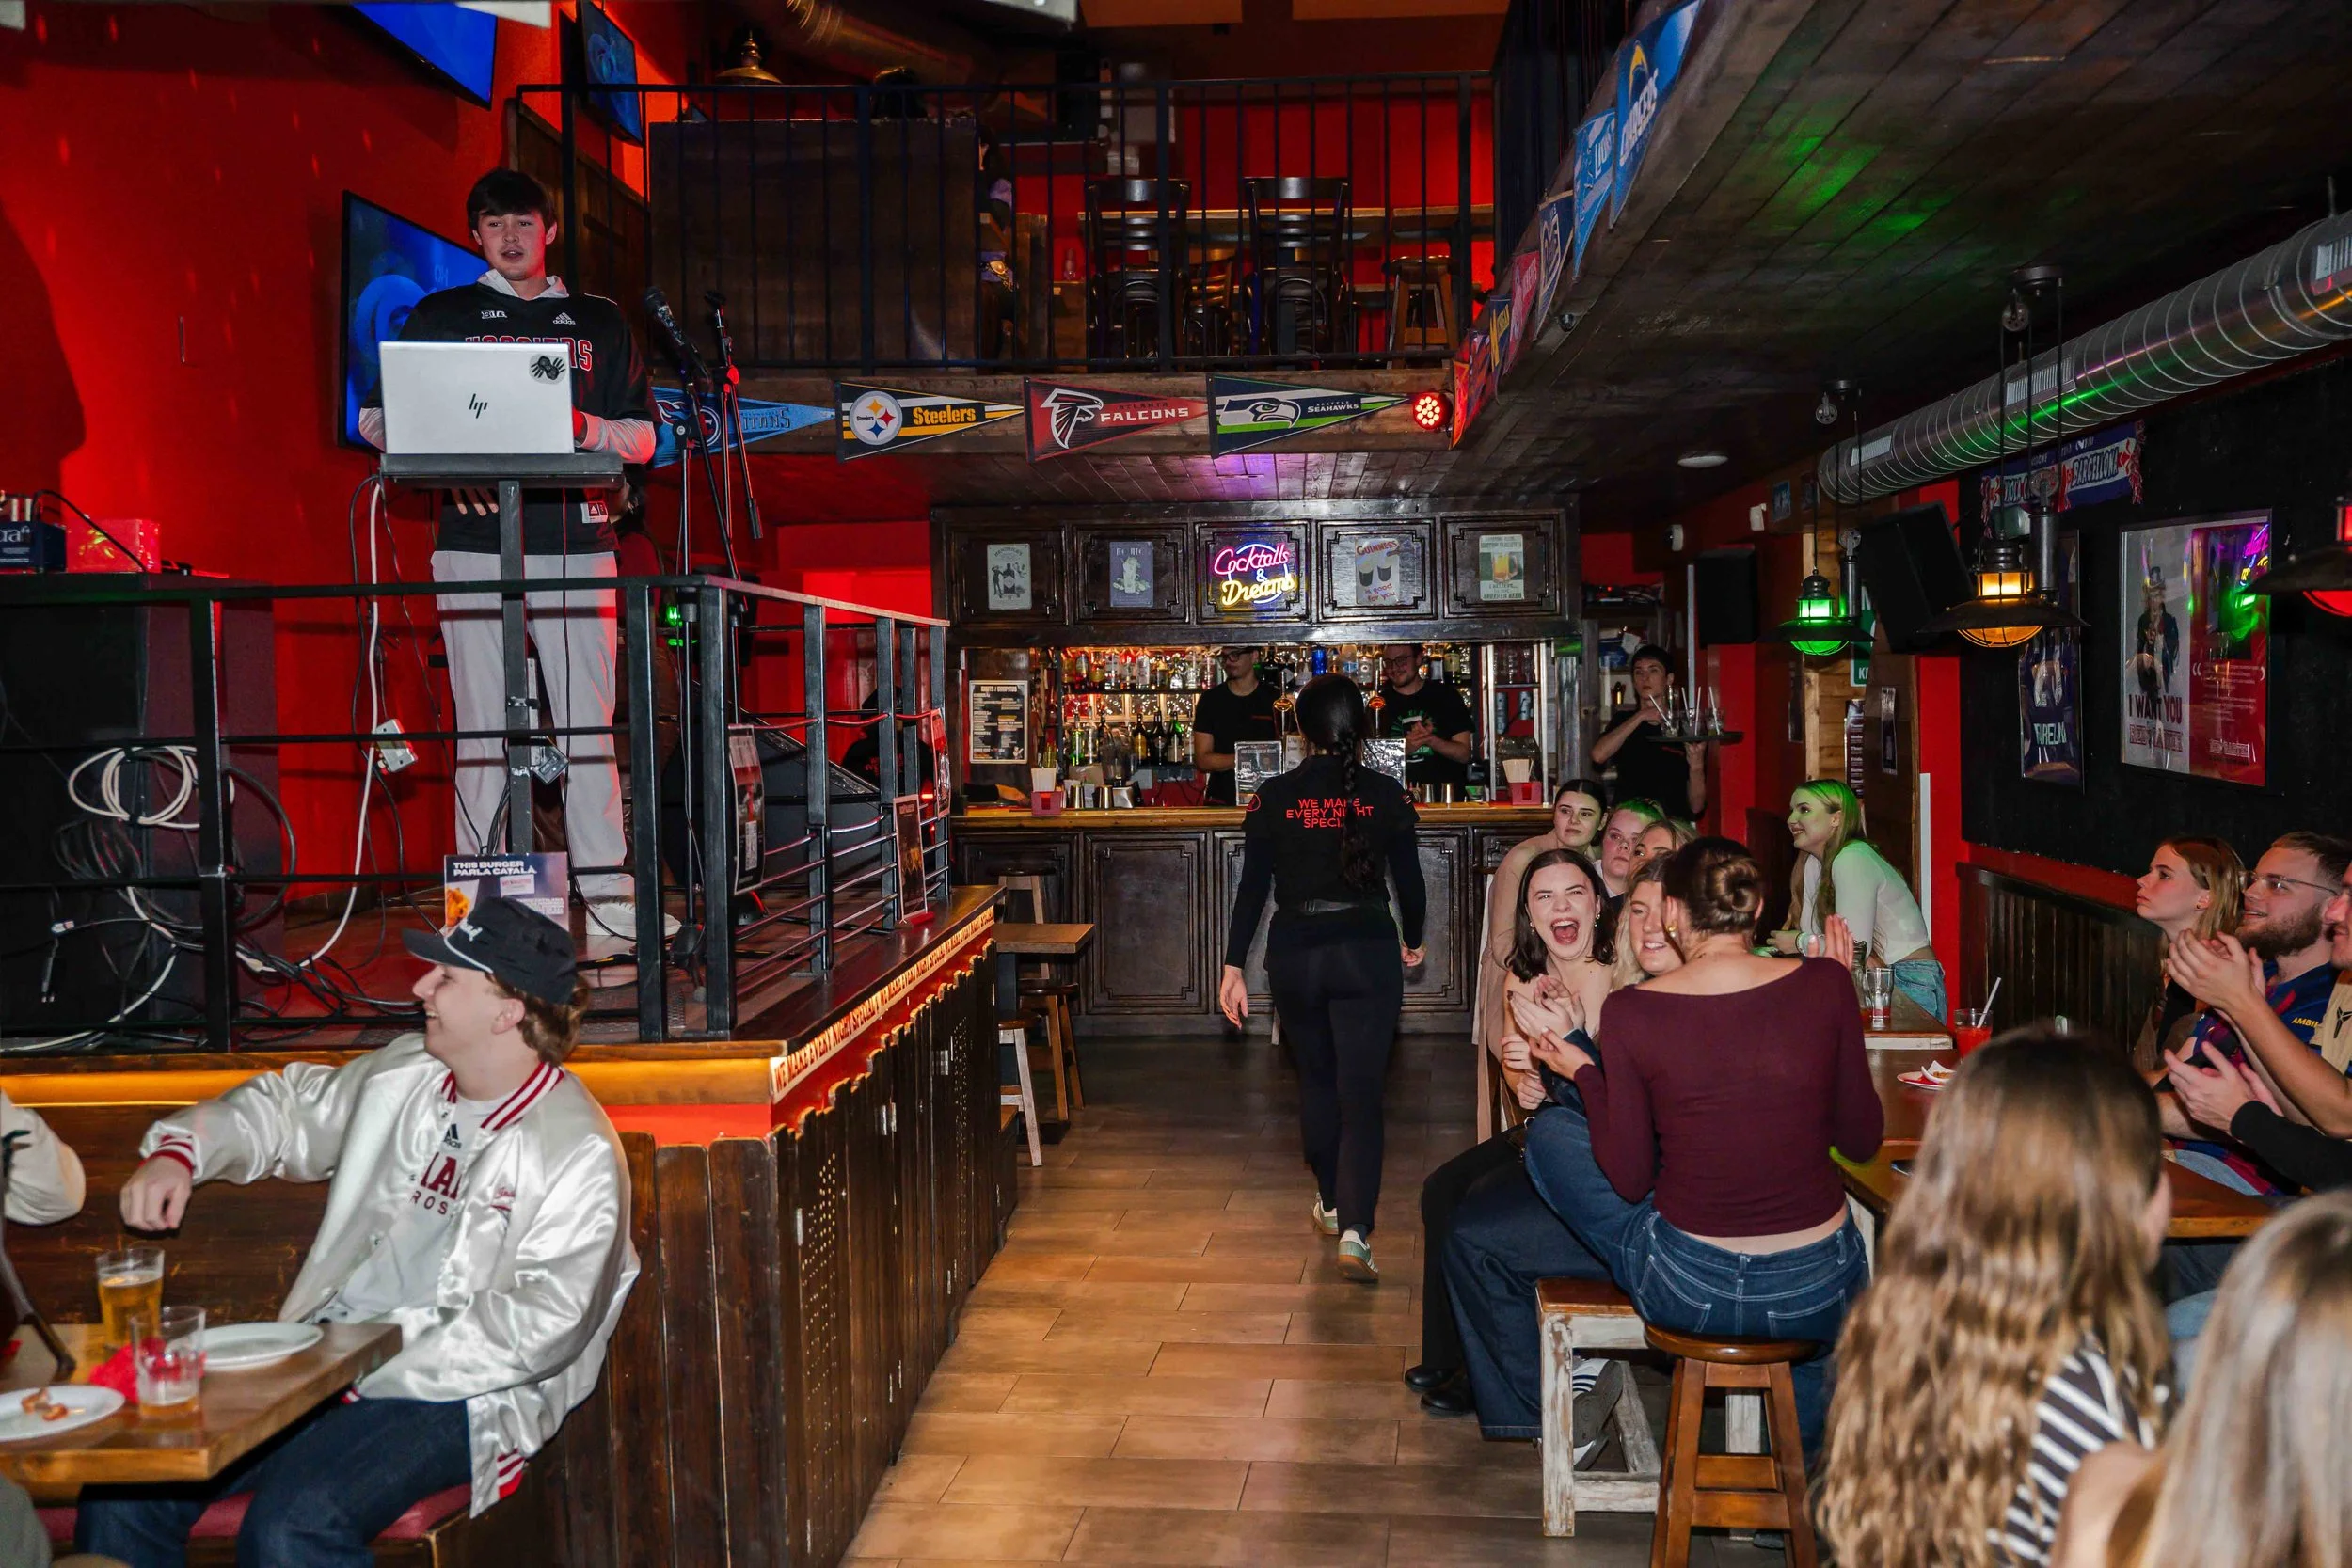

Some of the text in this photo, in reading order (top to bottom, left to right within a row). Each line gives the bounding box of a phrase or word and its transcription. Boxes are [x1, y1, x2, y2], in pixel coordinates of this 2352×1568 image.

[913, 405, 977, 425] Steelers
[1100, 407, 1189, 422] FALCONS
[1307, 404, 1359, 413] SEAHAWKS
[1356, 539, 1398, 556] GUINNESS
[1214, 543, 1291, 575] Cocktails
[1256, 568, 1268, 582] &
[1221, 573, 1295, 606] Dreams
[1374, 582, 1393, 595] good
[1380, 591, 1396, 602] you
[2135, 695, 2163, 721] WANT
[2165, 694, 2183, 725] YOU
[1298, 798, 1319, 809] WE
[1285, 805, 1375, 819] EVERY NIHT
[1304, 817, 1343, 828] SPECI
[453, 860, 524, 869] THIS BURGER
